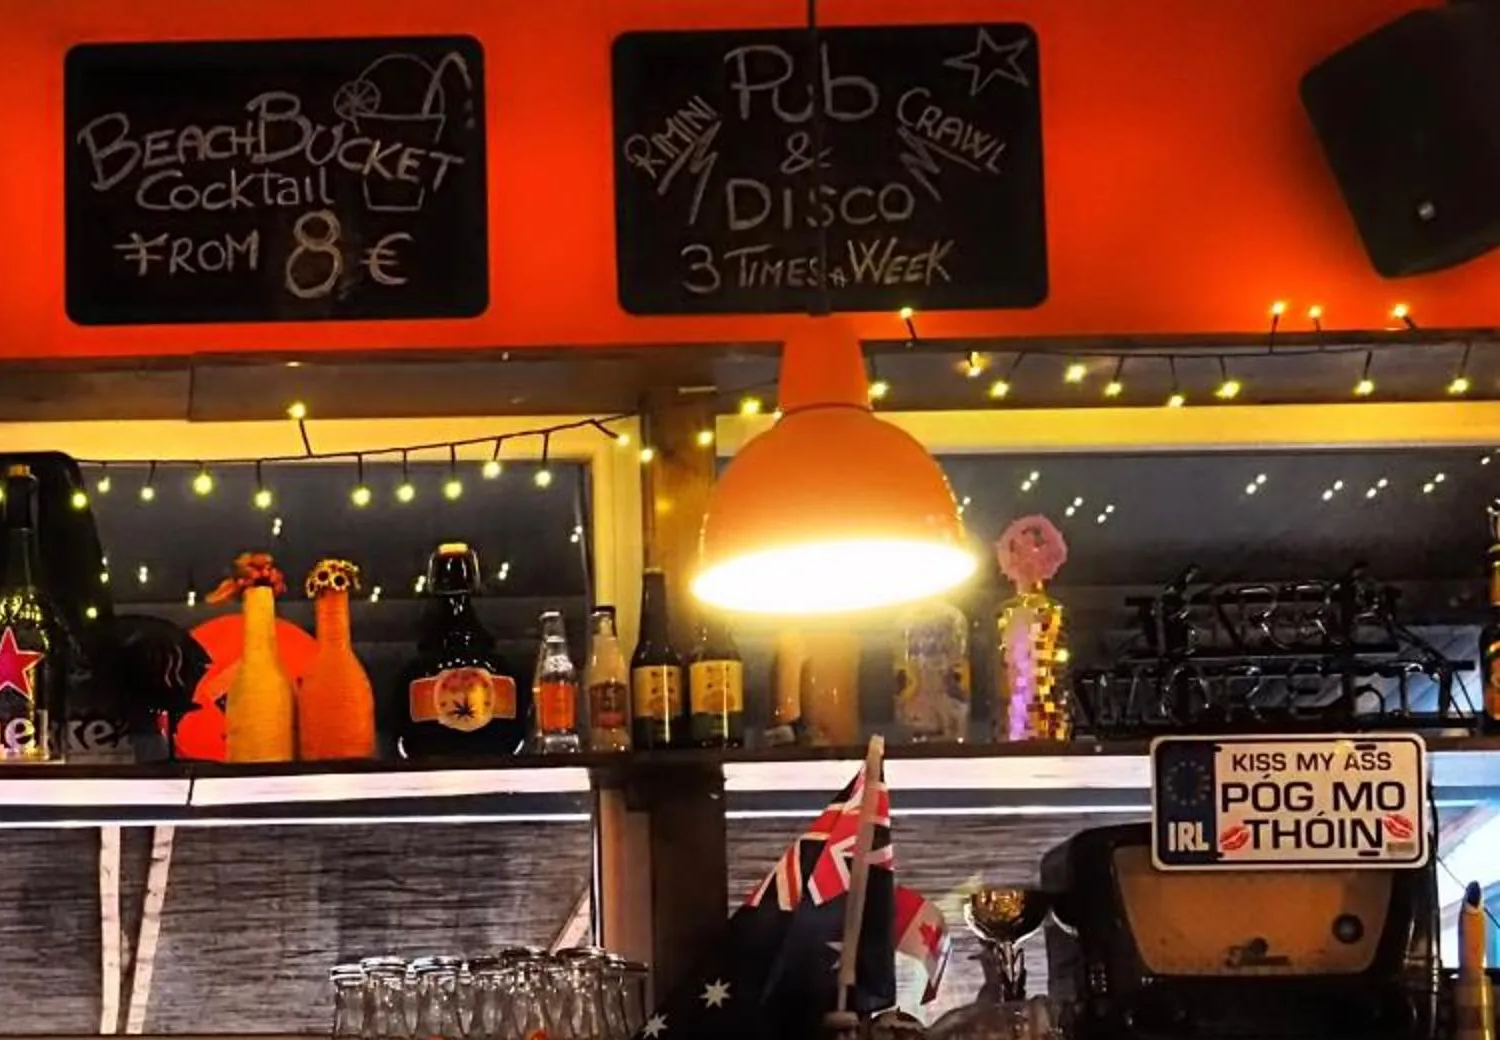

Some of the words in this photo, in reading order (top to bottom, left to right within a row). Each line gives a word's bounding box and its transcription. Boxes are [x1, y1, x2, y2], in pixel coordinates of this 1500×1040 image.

[723, 42, 880, 123] Pub
[77, 112, 257, 192] BEACH
[246, 91, 465, 191] BUCKET
[624, 95, 719, 180] RIMINI
[780, 131, 832, 175] &
[897, 86, 1007, 174] CRAWL
[136, 165, 336, 212] Cocktail
[725, 179, 915, 231] DISCO
[113, 229, 261, 277] FROM
[286, 208, 344, 299] 8
[361, 232, 413, 285] €
[681, 243, 721, 294] 3
[723, 244, 820, 288] TIMES
[846, 237, 956, 287] WEEK
[1231, 752, 1287, 772] KISS
[1296, 752, 1334, 772] MY
[1343, 752, 1392, 771] ASS
[1221, 773, 1314, 812] PÓG
[1332, 781, 1406, 812] MO
[1168, 821, 1210, 852] IRL
[1243, 811, 1383, 849] THÓIN
